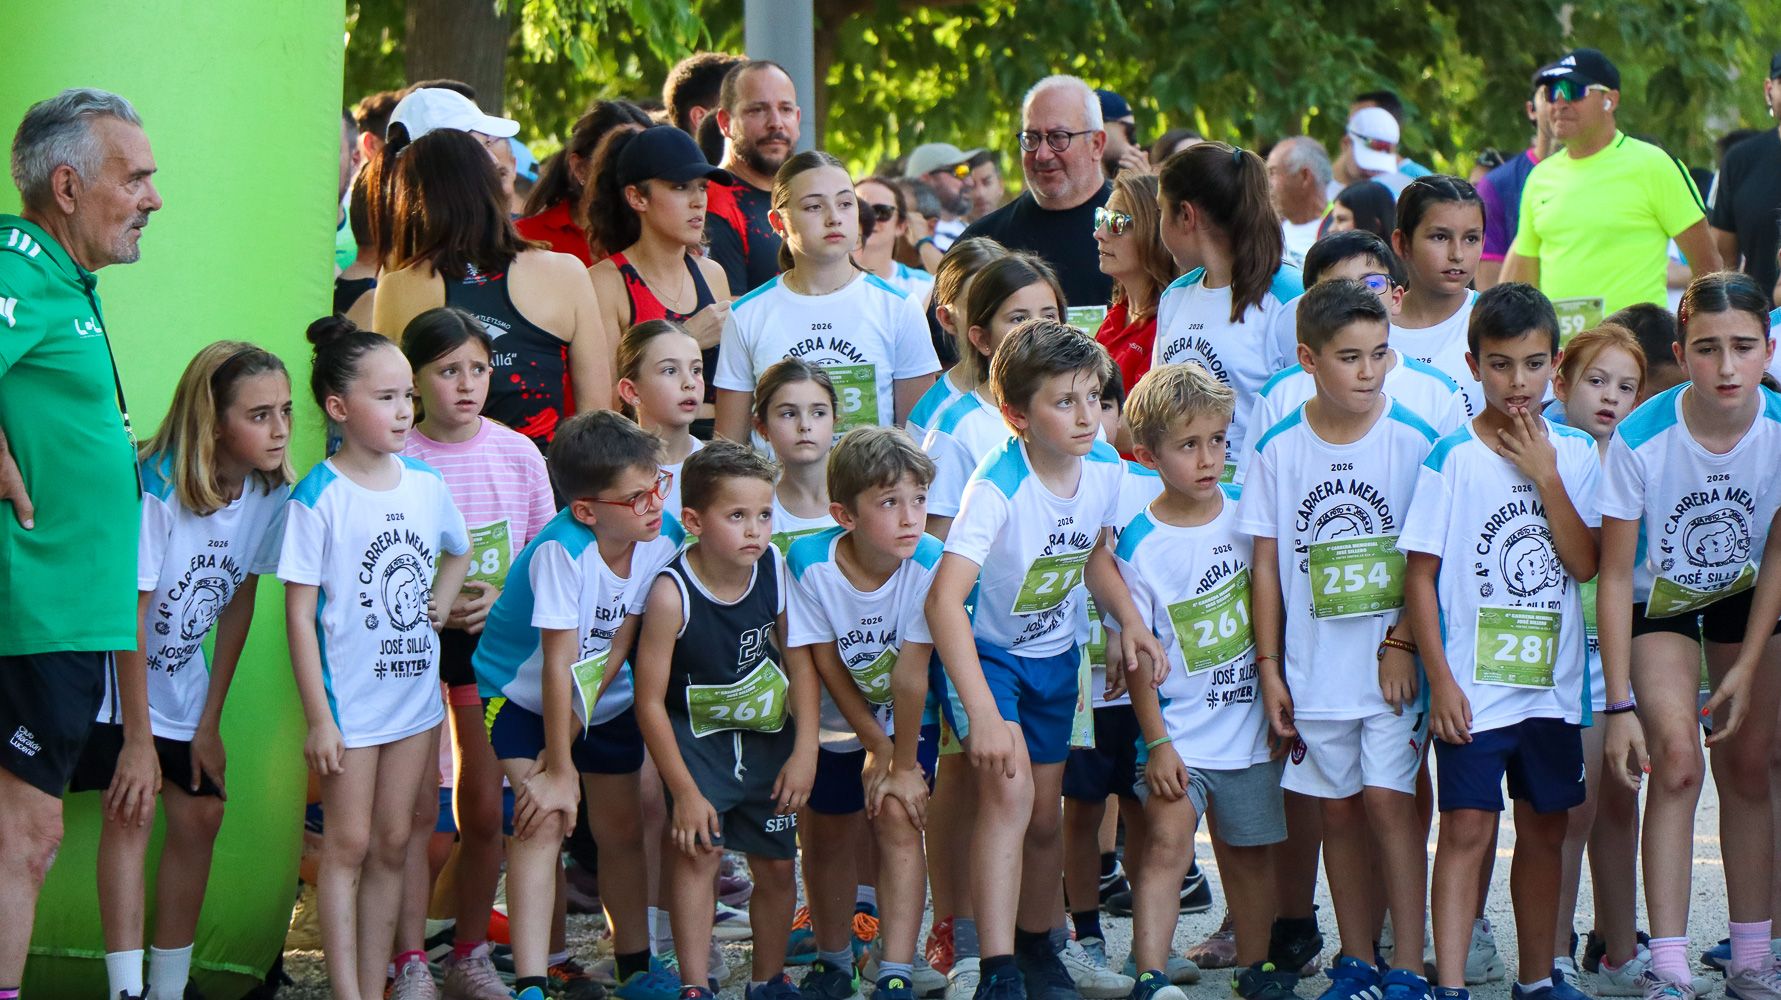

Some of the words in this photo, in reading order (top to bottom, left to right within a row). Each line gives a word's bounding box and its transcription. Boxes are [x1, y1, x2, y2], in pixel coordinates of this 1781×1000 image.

[811, 323, 833, 331] 2026
[829, 336, 868, 363] MEM
[1330, 462, 1354, 472] 2026
[1706, 473, 1730, 483] 2026
[1511, 484, 1533, 493] 2026
[1296, 478, 1345, 533] CARRERA
[1664, 488, 1720, 535] CARRERA
[386, 513, 405, 521] 2026
[1057, 516, 1074, 527] 2026
[1476, 499, 1528, 556] CARRERA
[207, 539, 229, 548] 2026
[1212, 543, 1233, 555] 2026
[359, 528, 402, 585] CARRERA
[168, 554, 216, 601] CARERA
[1034, 568, 1080, 595] 21
[1323, 561, 1391, 595] 254
[861, 615, 883, 625] 2026
[1193, 598, 1250, 650] 261
[380, 633, 404, 655] JOSÉ
[1494, 633, 1554, 665] 281
[1211, 663, 1236, 686] JOSÉ
[708, 687, 775, 721] 267
[14, 730, 42, 752] Maratón
[19, 725, 34, 739] Club
[10, 736, 36, 757] Lucena
